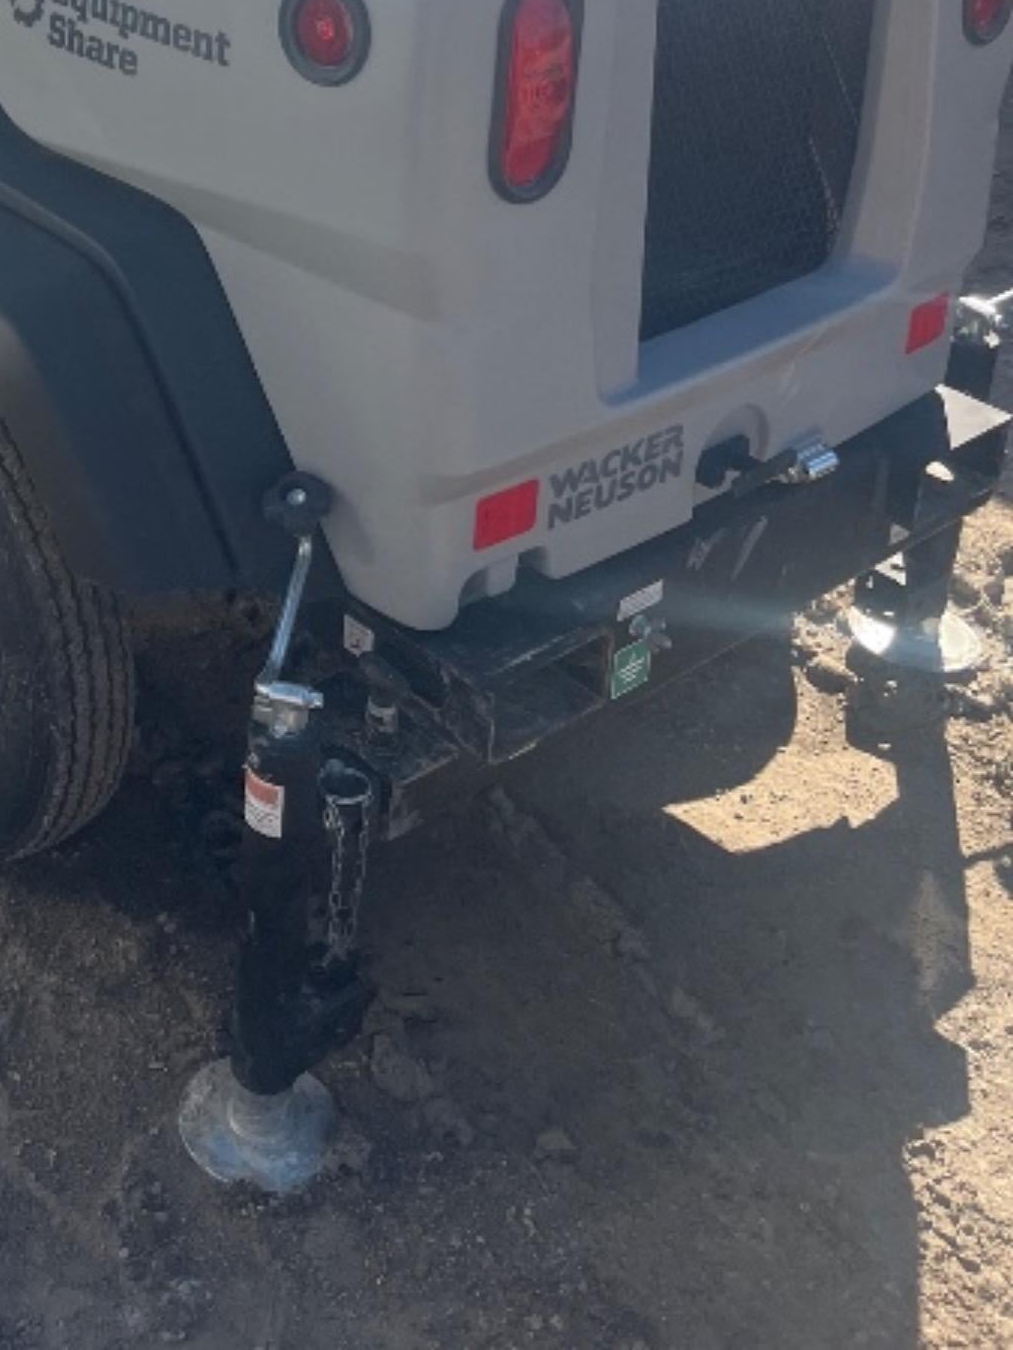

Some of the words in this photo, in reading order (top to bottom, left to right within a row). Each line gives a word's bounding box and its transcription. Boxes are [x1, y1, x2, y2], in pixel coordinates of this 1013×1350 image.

[47, 11, 138, 77] Share
[548, 449, 684, 531] NEUSON
[549, 424, 684, 499] WACKER
